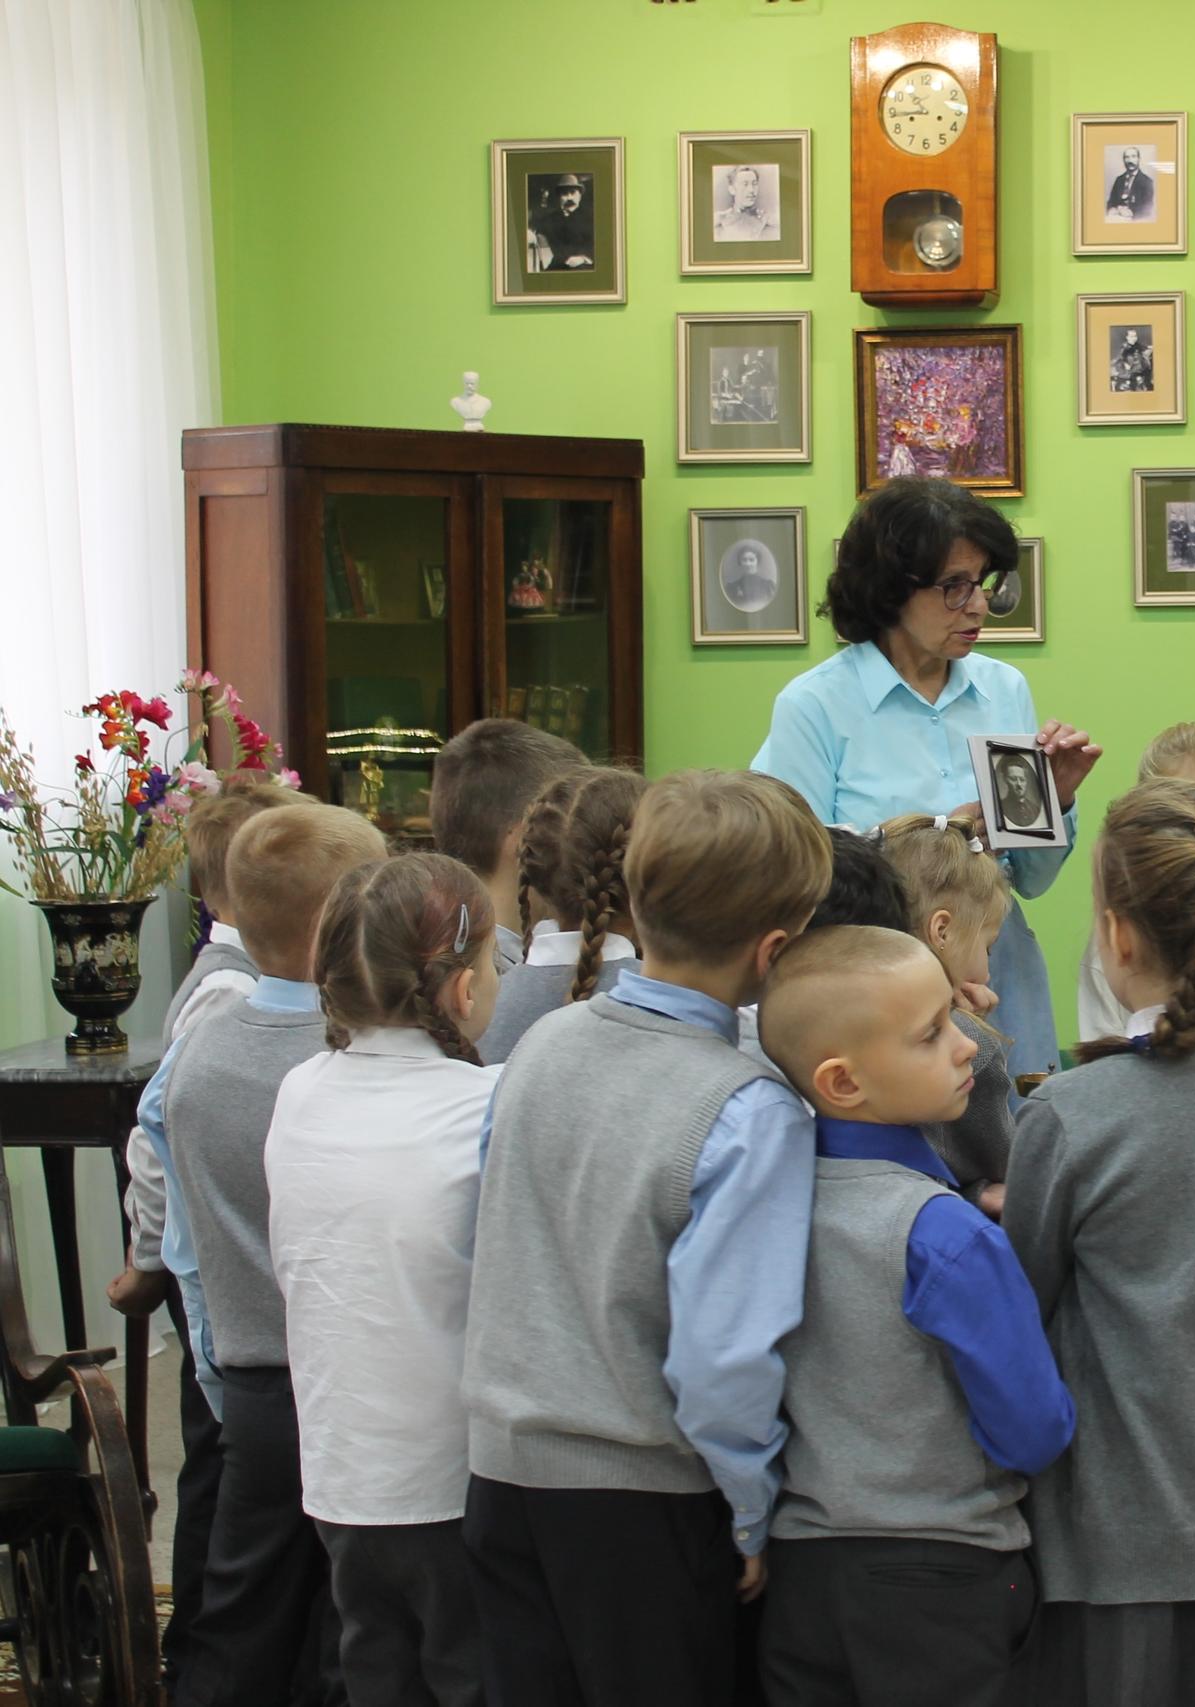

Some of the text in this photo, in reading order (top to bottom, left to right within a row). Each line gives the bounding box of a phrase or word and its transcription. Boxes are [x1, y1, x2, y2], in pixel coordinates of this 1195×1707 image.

[921, 74, 932, 86] 12
[950, 90, 959, 101] 2
[888, 107, 897, 118] 9
[894, 123, 902, 134] 8
[950, 121, 958, 132] 4
[907, 135, 915, 146] 7
[922, 139, 930, 150] 6
[939, 133, 947, 145] 5
